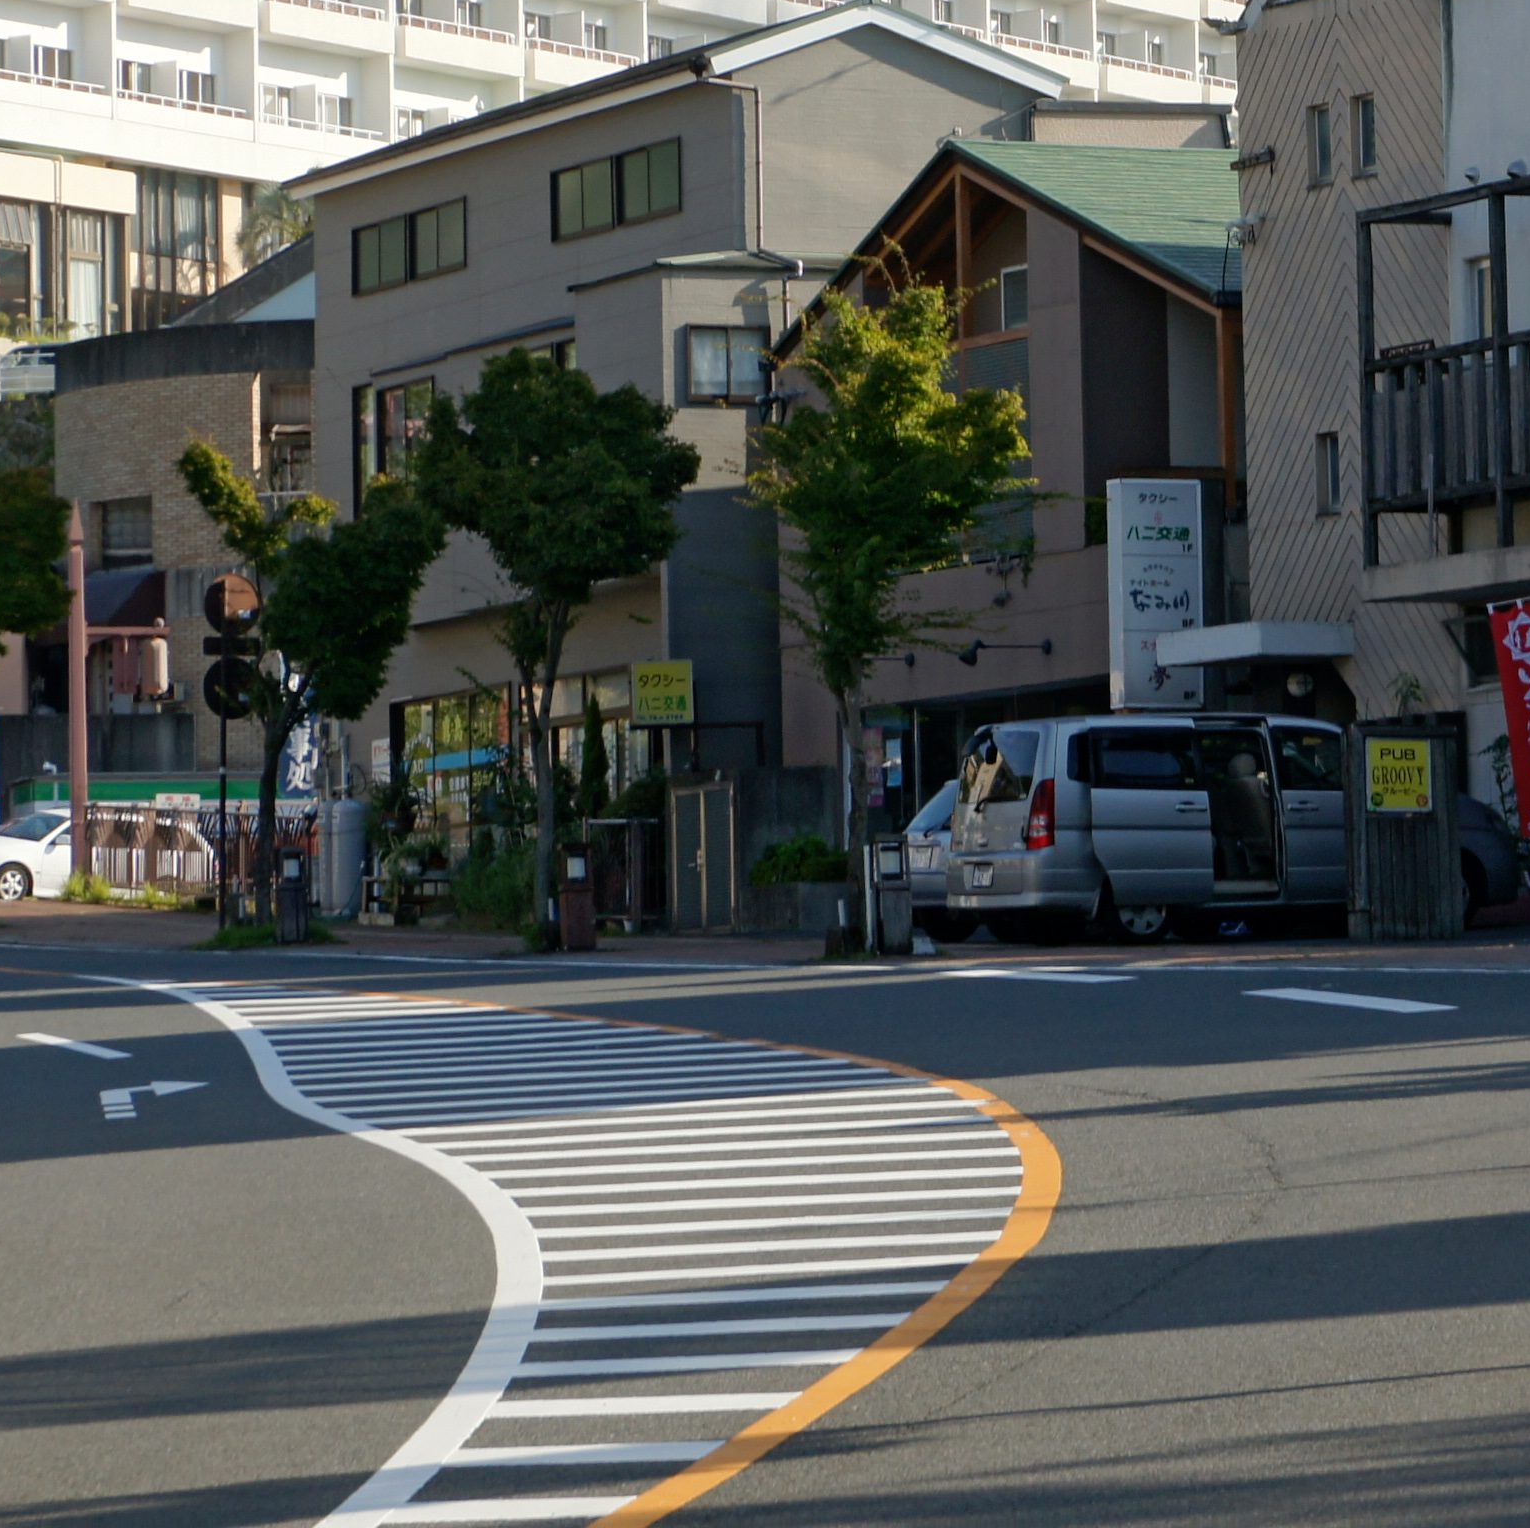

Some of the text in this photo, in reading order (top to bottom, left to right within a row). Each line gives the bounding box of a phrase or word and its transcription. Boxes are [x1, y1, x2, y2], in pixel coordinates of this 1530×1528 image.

[1138, 493, 1178, 504] タクシー
[638, 674, 686, 689] タクシー
[1380, 748, 1416, 760] PUB
[1372, 766, 1424, 785] GROOVY
